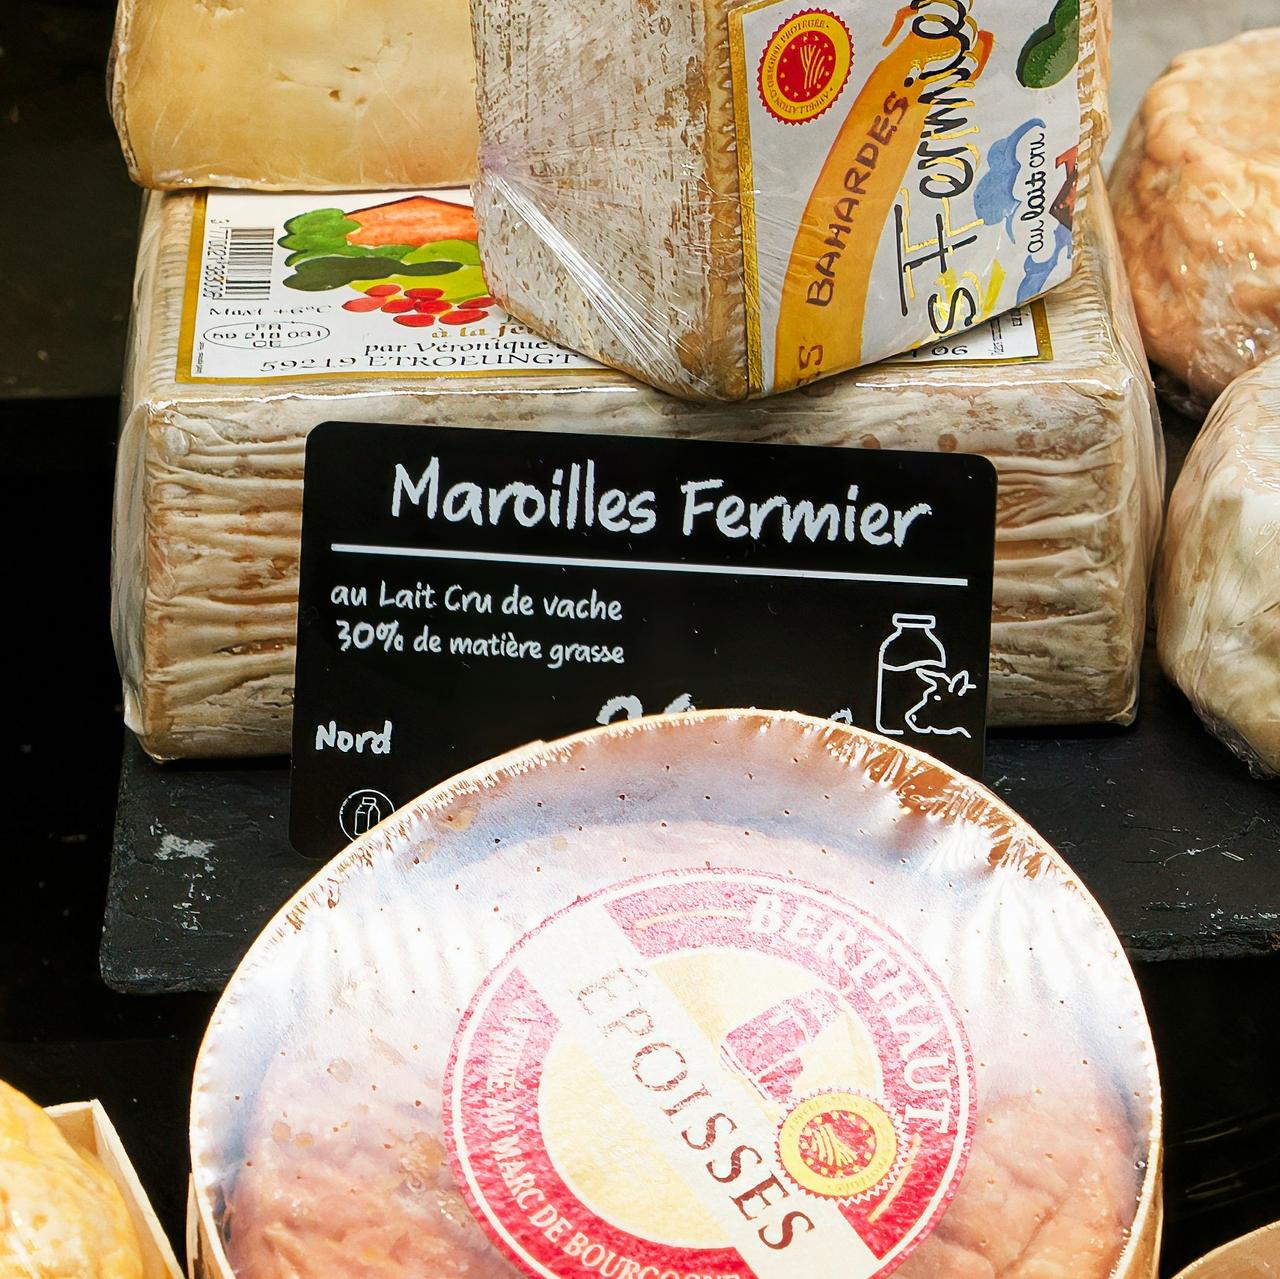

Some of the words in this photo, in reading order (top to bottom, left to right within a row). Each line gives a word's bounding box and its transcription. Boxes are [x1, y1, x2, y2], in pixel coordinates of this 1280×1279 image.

[1023, 132, 1045, 169] cru
[806, 92, 912, 307] BAHARDES
[1020, 171, 1047, 225] lait
[1026, 224, 1046, 254] au
[365, 343, 407, 356] par
[459, 327, 486, 337] la
[391, 457, 658, 534] Maroilles
[680, 478, 932, 548] Fermier
[330, 582, 368, 610] au
[380, 582, 435, 610] Lait
[444, 586, 492, 615] Cru
[501, 588, 534, 617] de
[542, 591, 622, 621] vache
[336, 620, 404, 654] 30%
[412, 626, 442, 654] de
[449, 630, 542, 659] matière
[549, 638, 625, 668] grasse
[314, 721, 392, 755] Nord
[570, 963, 816, 1251] EPOISSES
[491, 1132, 546, 1211] MARC
[529, 1203, 573, 1243] DE
